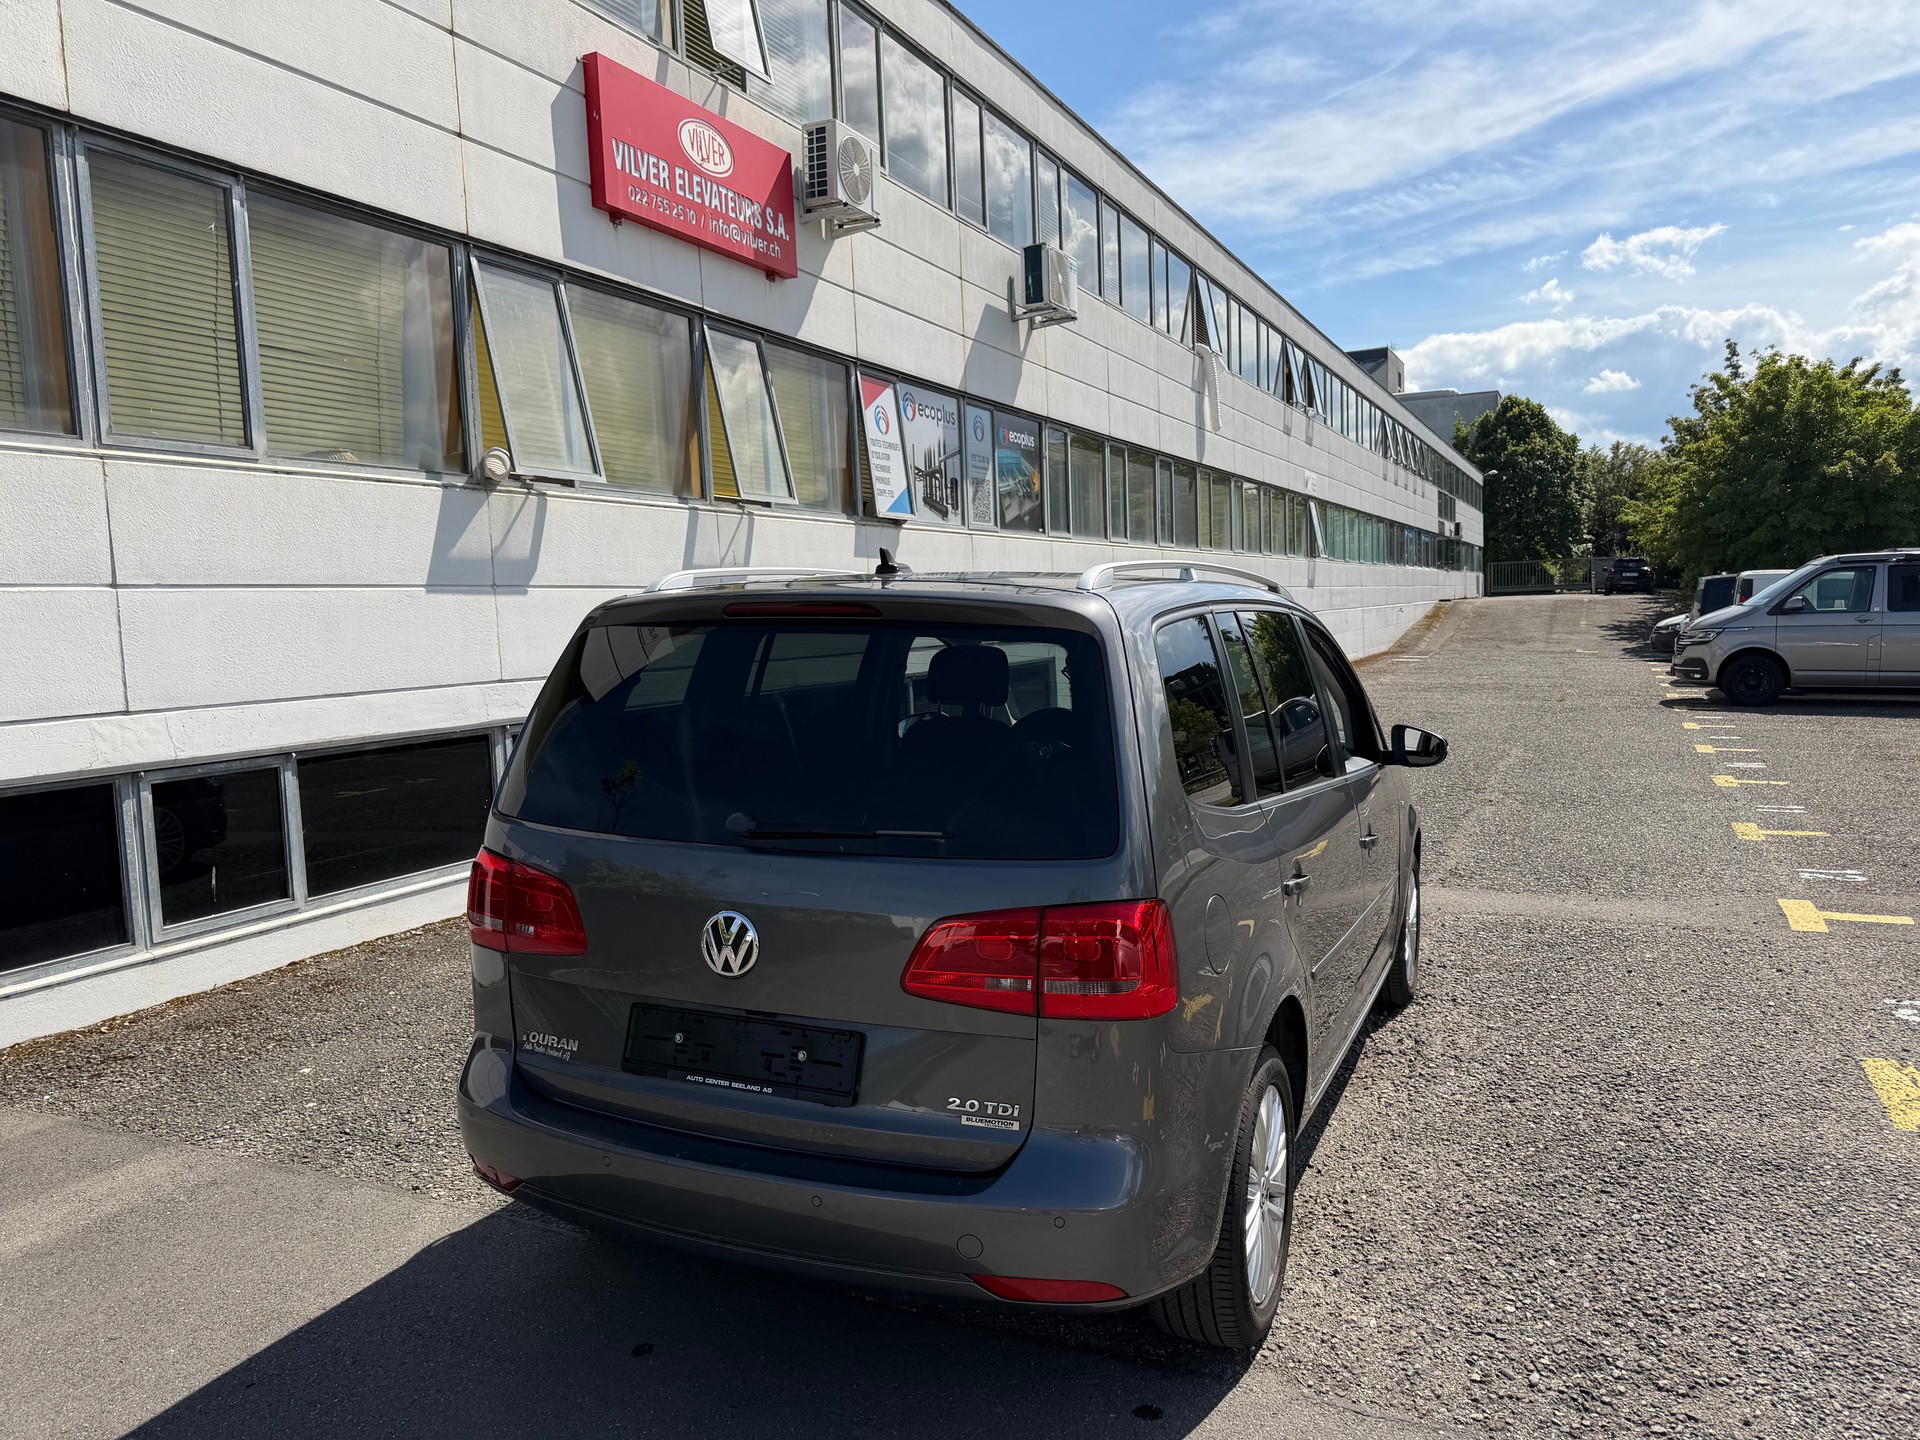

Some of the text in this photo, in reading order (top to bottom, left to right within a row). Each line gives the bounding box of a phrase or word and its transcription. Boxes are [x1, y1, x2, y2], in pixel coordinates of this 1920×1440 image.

[688, 128, 726, 167] VILVER
[611, 137, 790, 242] VILVER ELEVATEURS S.A.
[628, 185, 782, 259] 022 755 25 10 / info@vilver.ch
[917, 402, 956, 428] ecoplus
[1008, 430, 1035, 449] ecoplus
[522, 1029, 579, 1051] TOURAN
[687, 1075, 703, 1083] AUTO
[705, 1078, 730, 1087] CENTER
[731, 1081, 761, 1092] SEELAND
[946, 1097, 1020, 1117] 2.0 TDI
[965, 1116, 1014, 1127] BLUEMOTION
